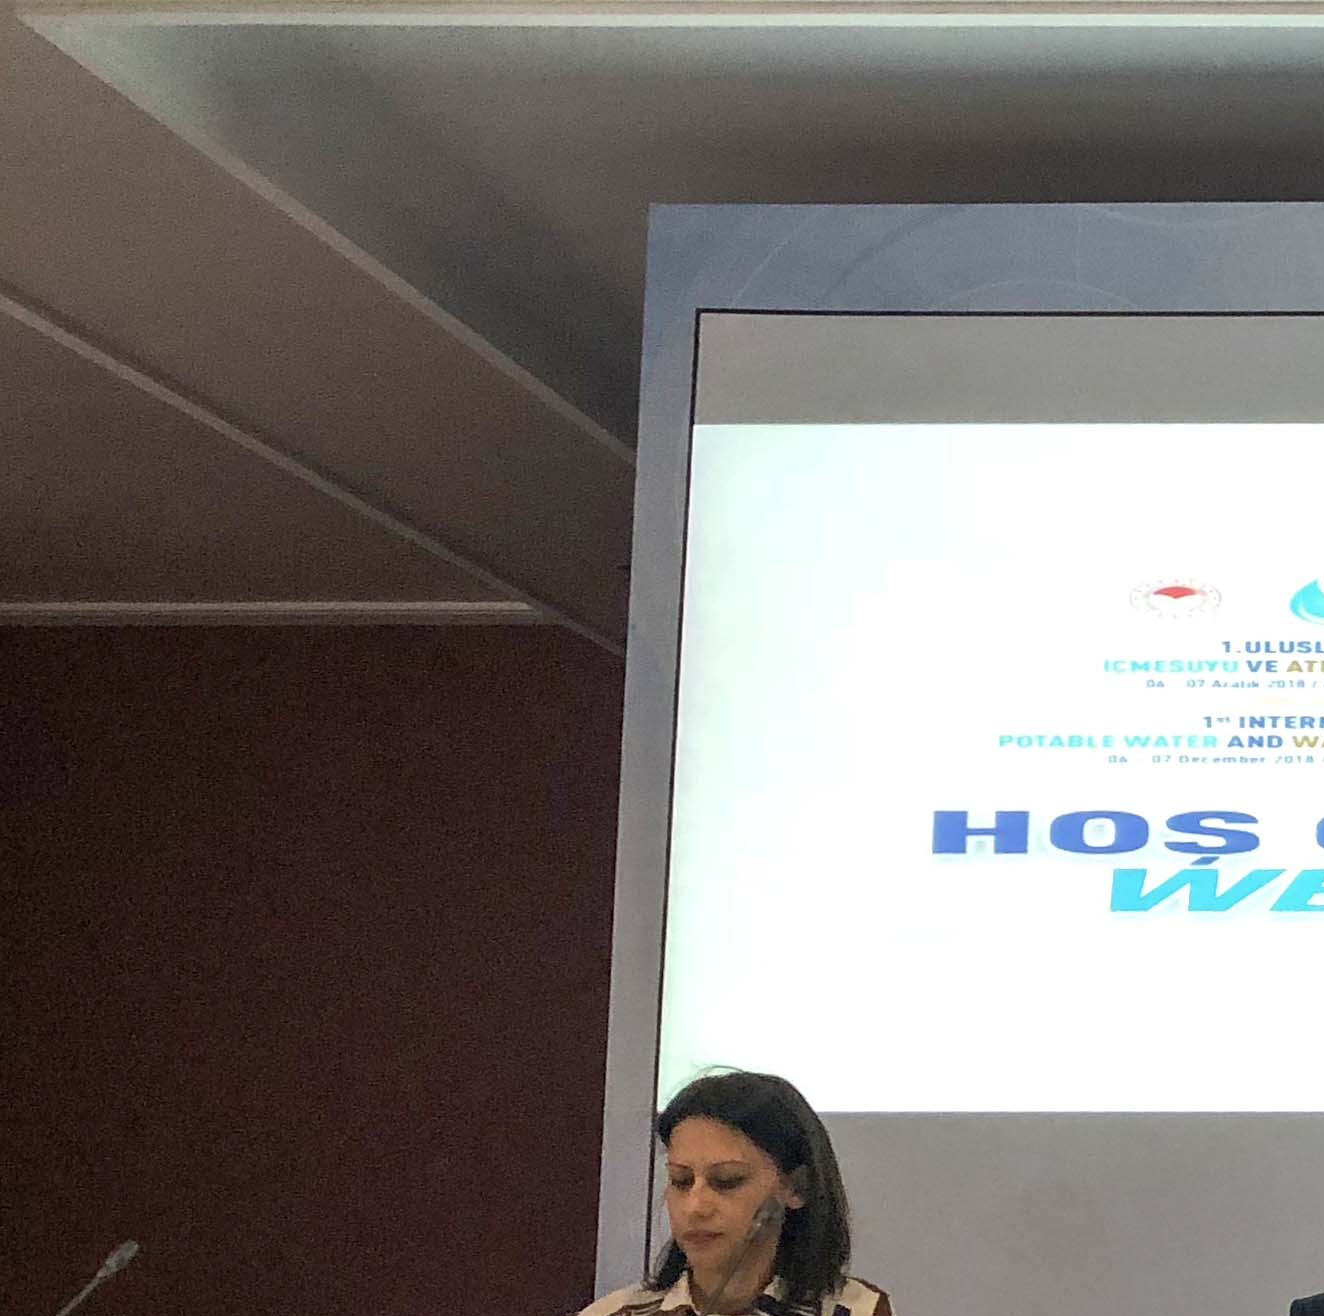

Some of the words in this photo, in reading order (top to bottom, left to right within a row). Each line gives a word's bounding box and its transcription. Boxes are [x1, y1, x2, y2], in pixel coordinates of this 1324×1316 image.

[1246, 660, 1278, 673] VE
[998, 735, 1114, 748] POTABLE
[1124, 735, 1218, 748] WATER
[1228, 735, 1284, 748] AND
[931, 811, 1261, 866] HOŞ
